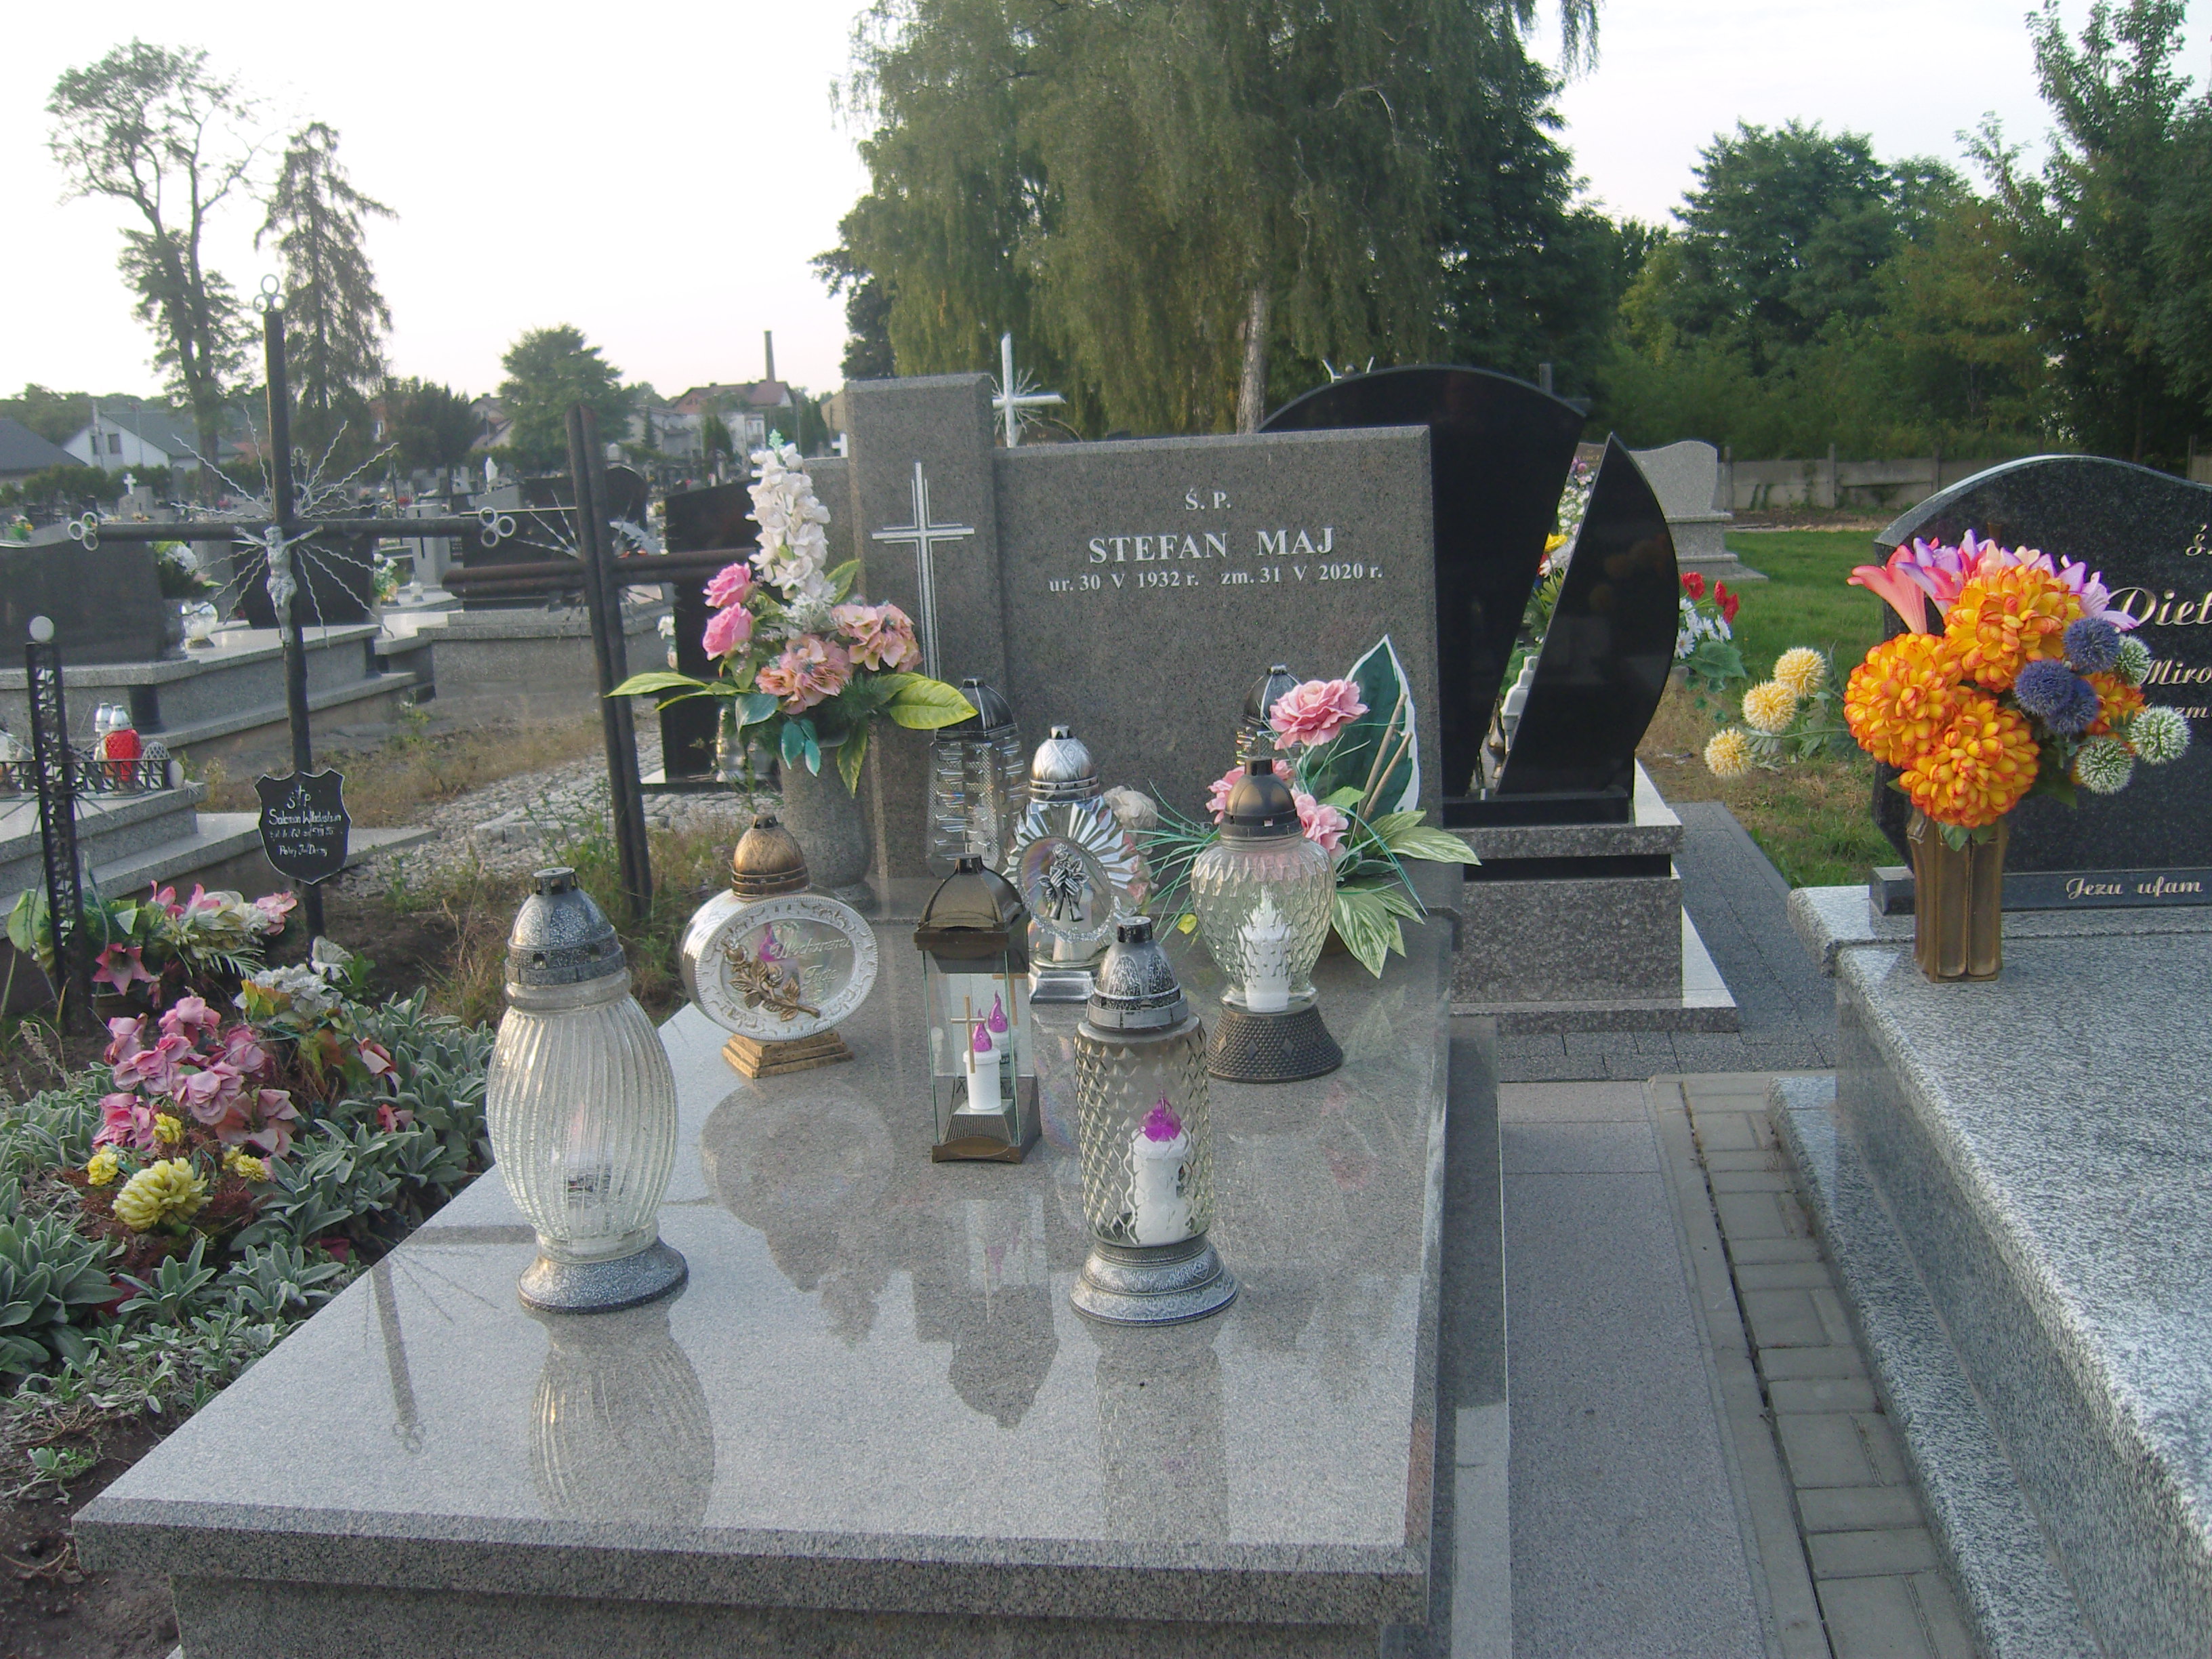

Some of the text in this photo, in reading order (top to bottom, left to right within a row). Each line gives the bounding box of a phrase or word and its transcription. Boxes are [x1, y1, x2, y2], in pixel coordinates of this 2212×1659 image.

[1088, 527, 1334, 565] STEFAN MAJ
[1049, 562, 1383, 593] ur. 30 V 1932 r. zm. 31 V 2020 r.
[2066, 876, 2203, 900] Jezu ufam
